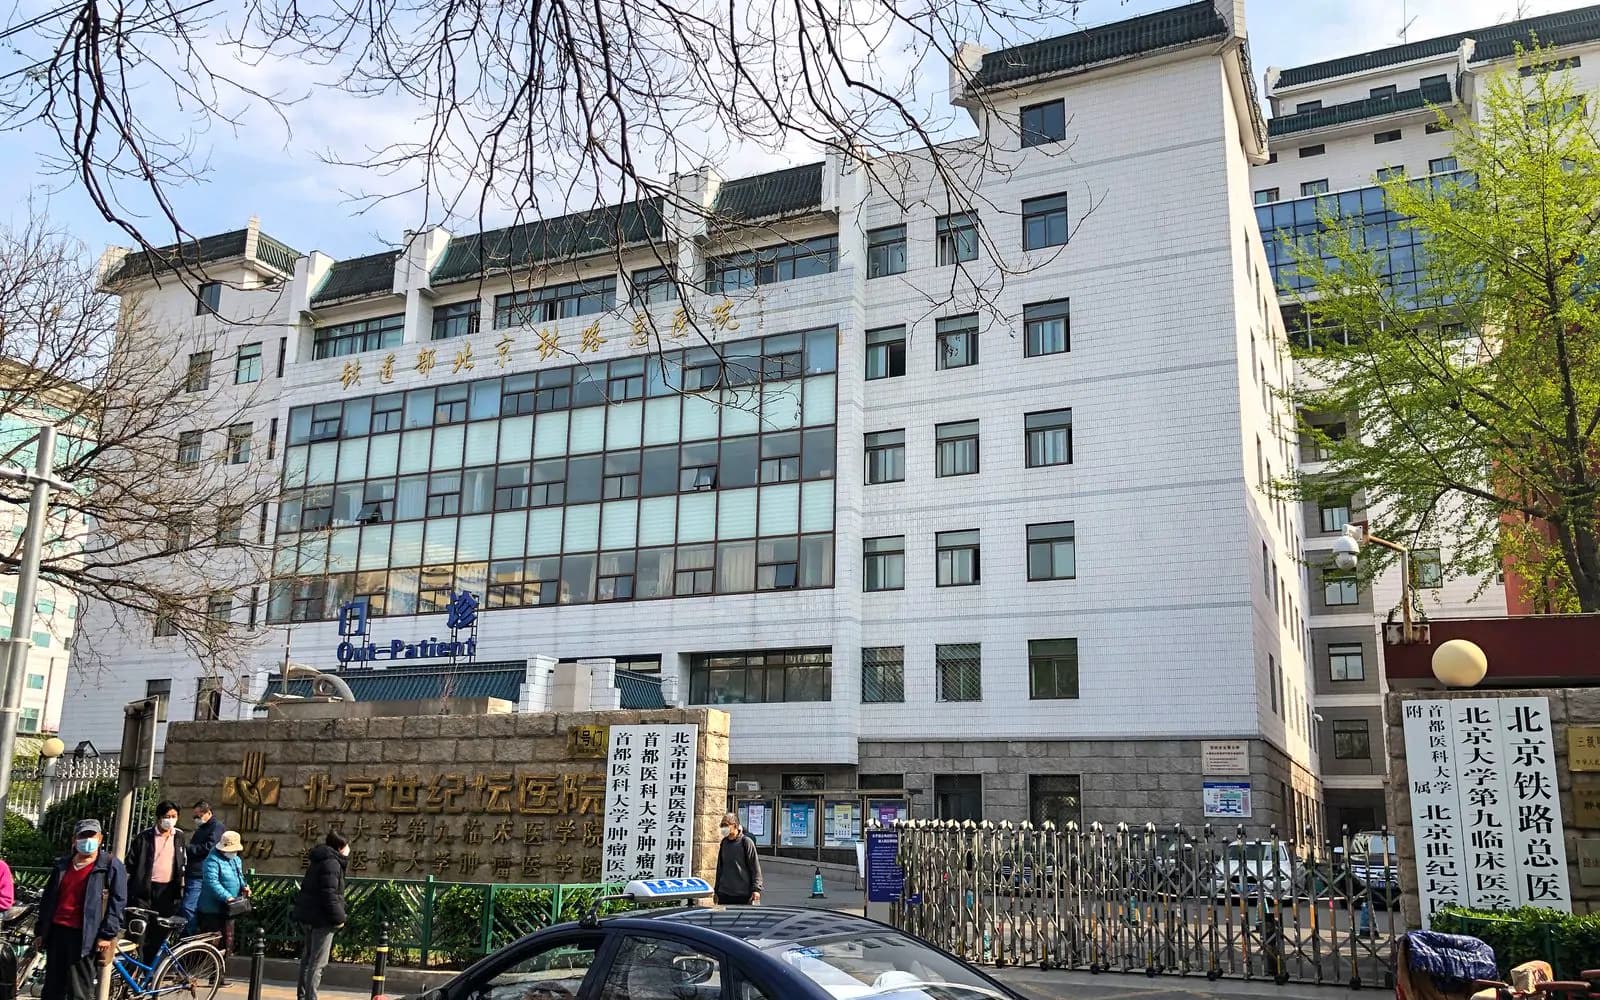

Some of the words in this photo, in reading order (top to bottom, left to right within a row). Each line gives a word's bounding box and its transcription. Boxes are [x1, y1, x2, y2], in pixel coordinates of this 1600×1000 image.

[338, 590, 478, 636] 门诊
[571, 729, 604, 747] 1号门
[1428, 704, 1452, 795] 首都医科大学
[303, 772, 606, 815] 北京世纪坛医院
[664, 731, 690, 878] 北京市中西医结合肿瘤研
[1507, 706, 1566, 910] 北京铁路总医
[300, 848, 601, 880] 首医科大学肿瘤医学院
[644, 878, 704, 889] TAXI
